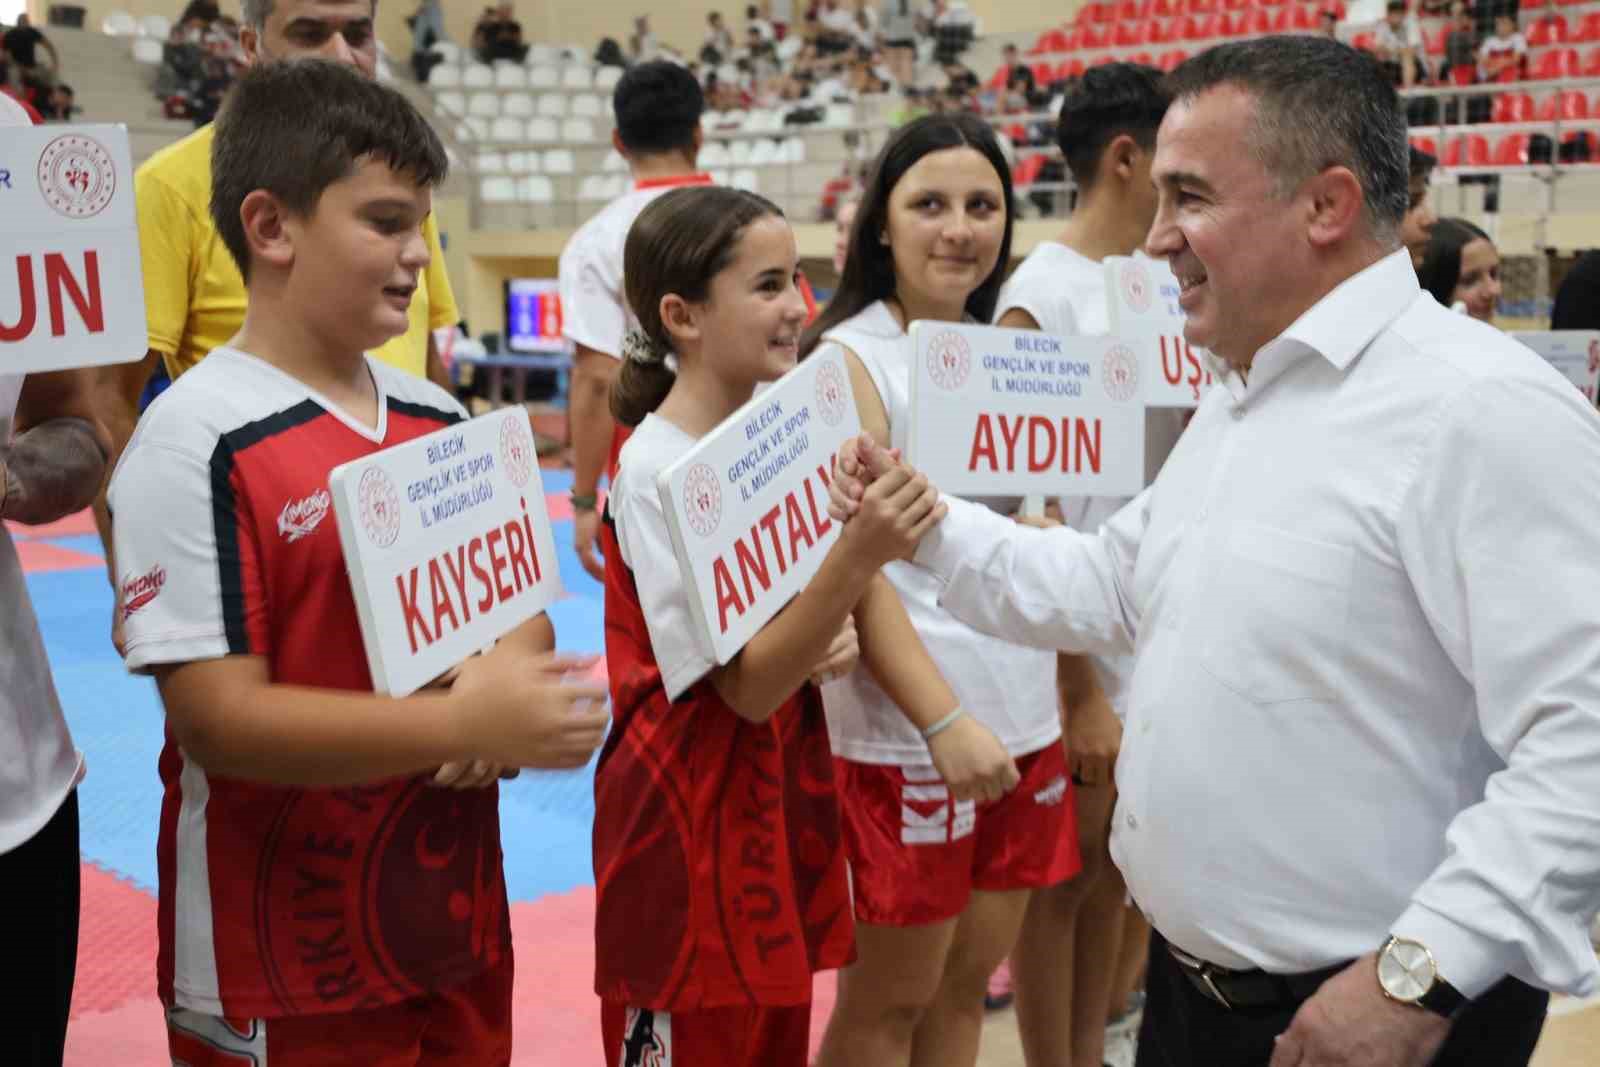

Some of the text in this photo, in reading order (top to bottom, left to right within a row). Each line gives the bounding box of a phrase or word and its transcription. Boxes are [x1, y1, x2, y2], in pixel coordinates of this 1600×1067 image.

[0, 250, 104, 342] UN
[983, 355, 1090, 376] GENÇLİK VE SPOR
[1014, 334, 1061, 352] BİLECİK
[1160, 335, 1212, 400] UŞ
[991, 375, 1082, 397] İL MÜDÜRLÜĞÜ
[427, 432, 466, 464] BİLECİK
[728, 405, 810, 483] GENÇLİK VE SPOR
[745, 400, 783, 440] BİLECİK
[968, 413, 1102, 475] AYDIN
[407, 452, 494, 503] GENÇLİK VE SPOR
[741, 431, 809, 503] İL MÜDÜRLÜĞÜ
[420, 478, 493, 529] İL MÜDÜRLÜĞÜ
[713, 453, 837, 635] ANTALY
[396, 495, 541, 656] KAYSERİ
